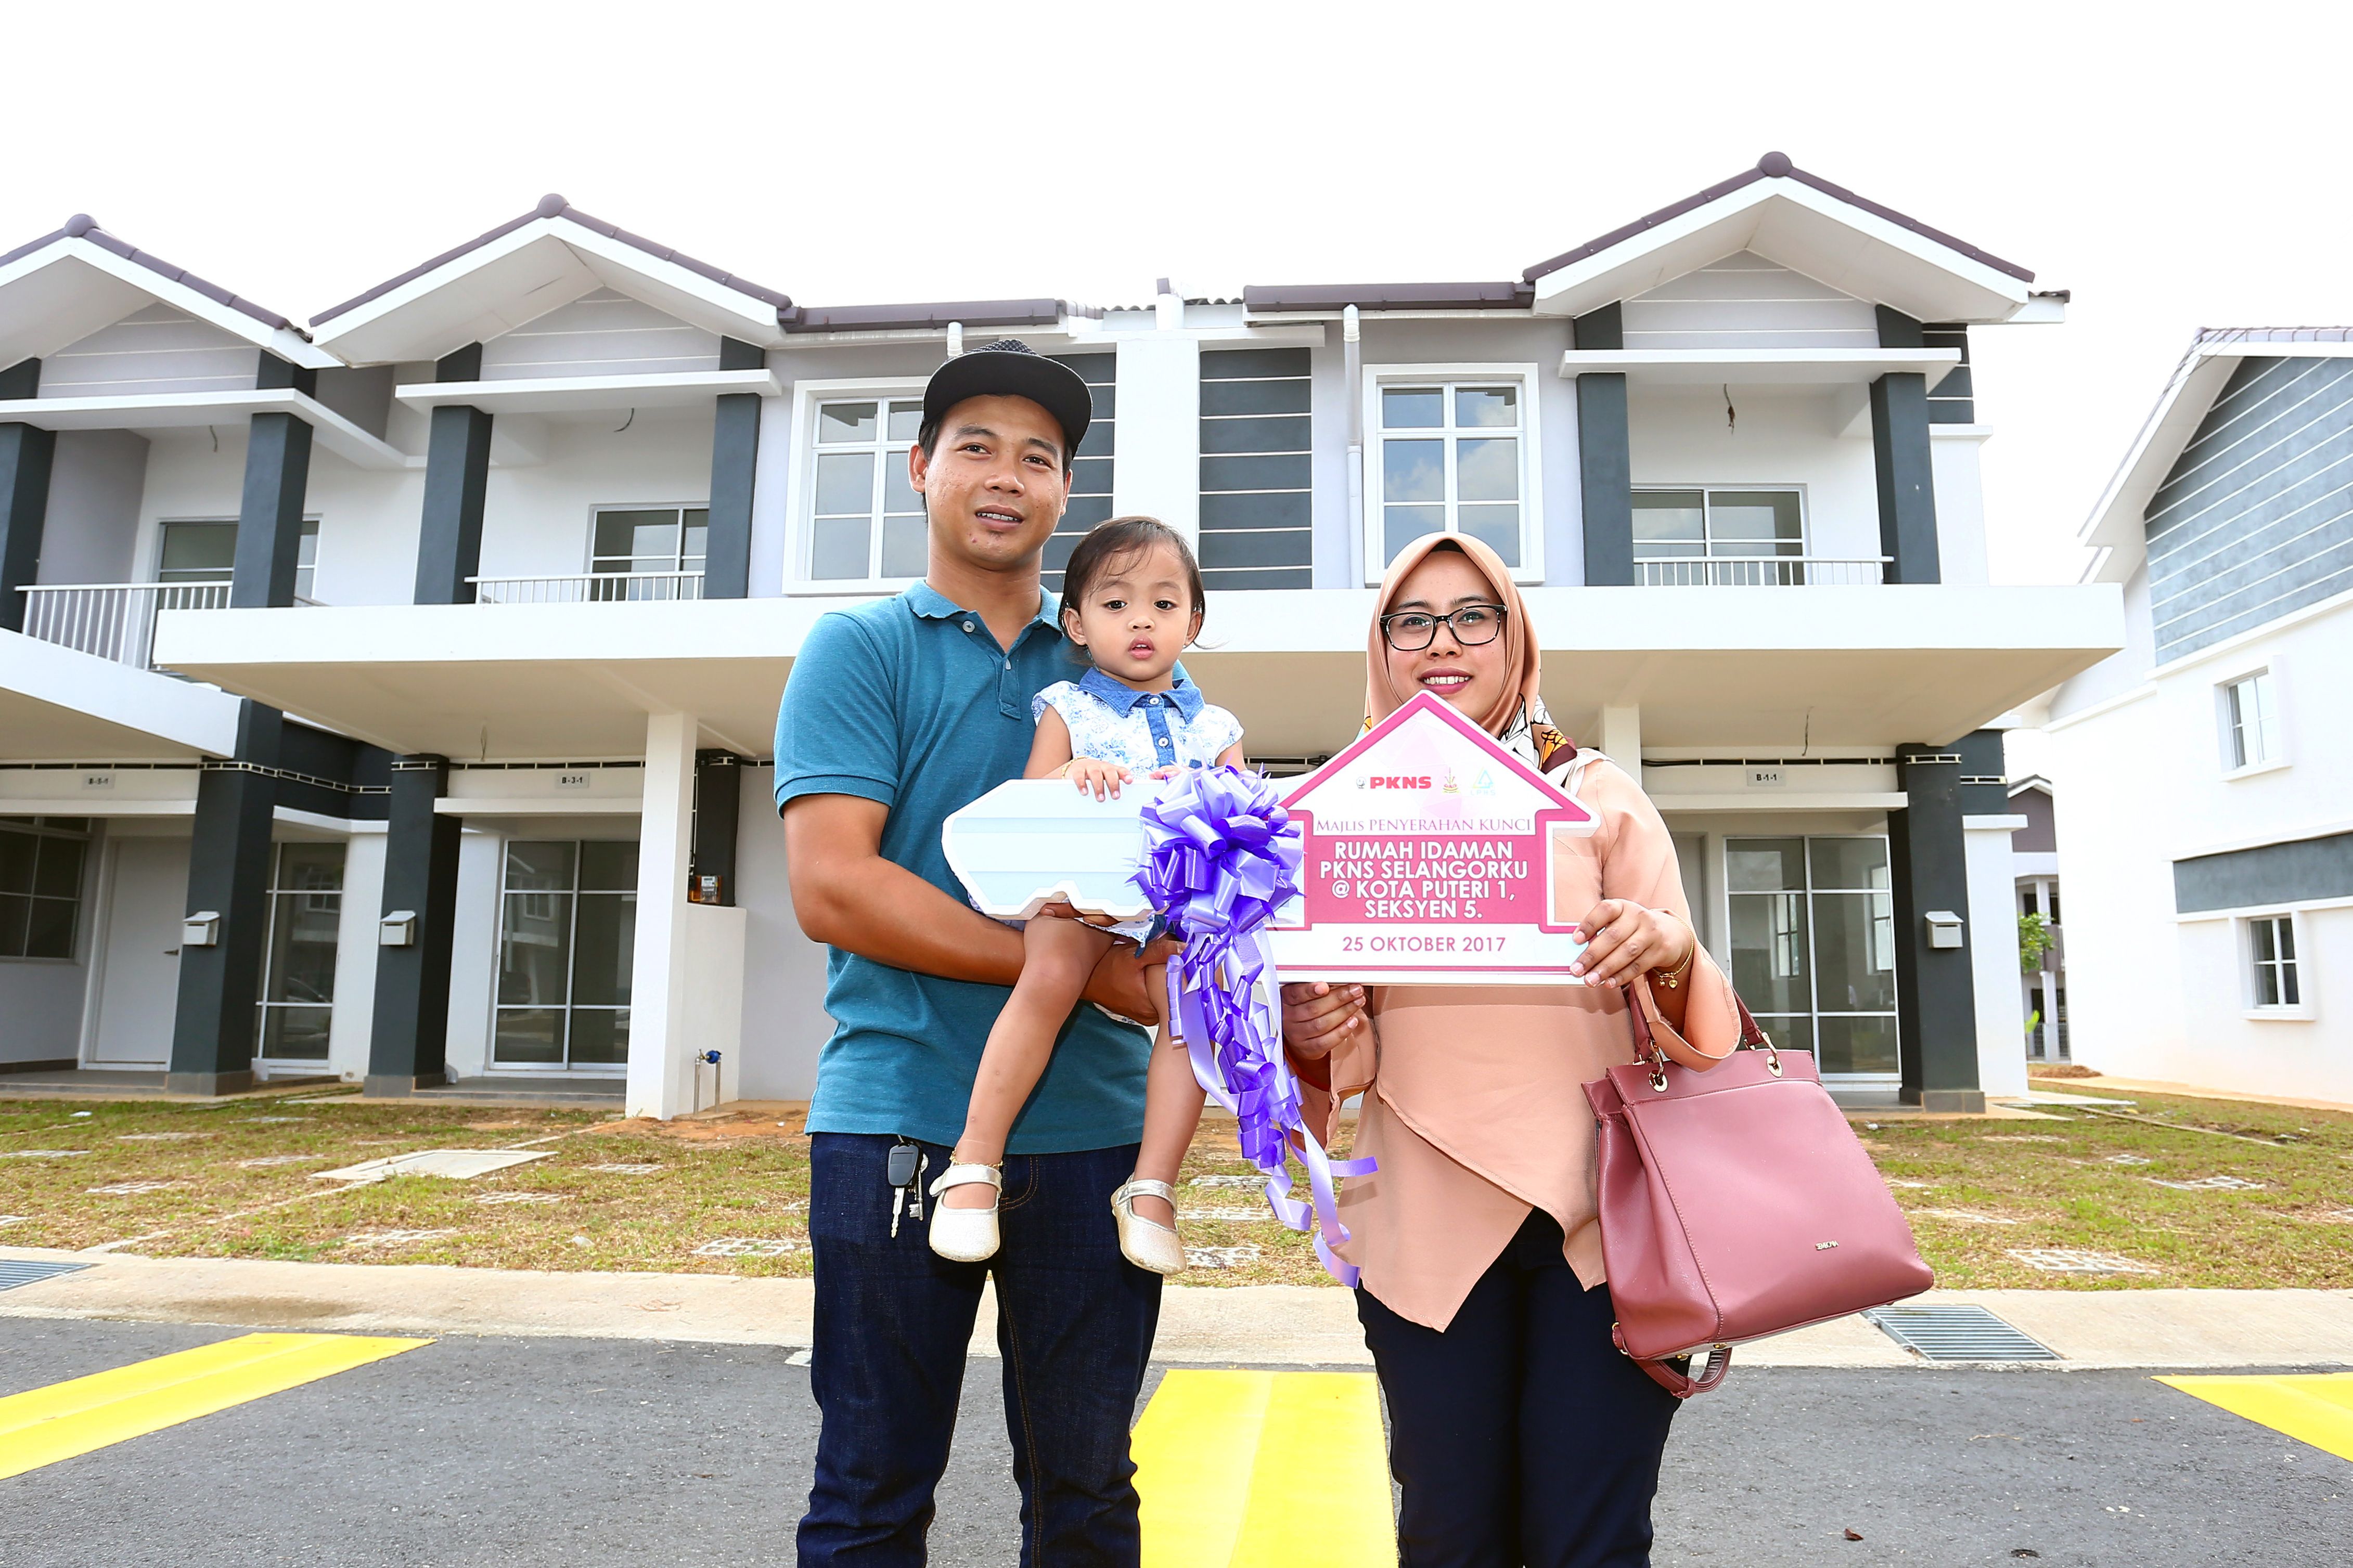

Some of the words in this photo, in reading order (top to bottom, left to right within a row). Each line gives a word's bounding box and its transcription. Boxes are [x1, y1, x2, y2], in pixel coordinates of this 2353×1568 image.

[1370, 776, 1432, 789] PKNS
[1369, 819, 1473, 831] PENYERAHAN
[1480, 819, 1531, 831] KUNCI
[1335, 841, 1413, 860] RUMAH
[1420, 841, 1513, 860] IDAMAN
[1320, 861, 1374, 879] PKNS
[1381, 861, 1528, 879] SELANGORKU
[1332, 880, 1350, 899] @
[1356, 880, 1416, 899] KOTA
[1422, 880, 1489, 898] PUTERI
[1497, 880, 1515, 901] 1,
[1364, 900, 1457, 918] SEKSYEN
[1463, 900, 1483, 918] 5.
[1342, 936, 1364, 952] 25
[1370, 936, 1456, 952] OKTOBER
[1462, 937, 1506, 952] 2017
